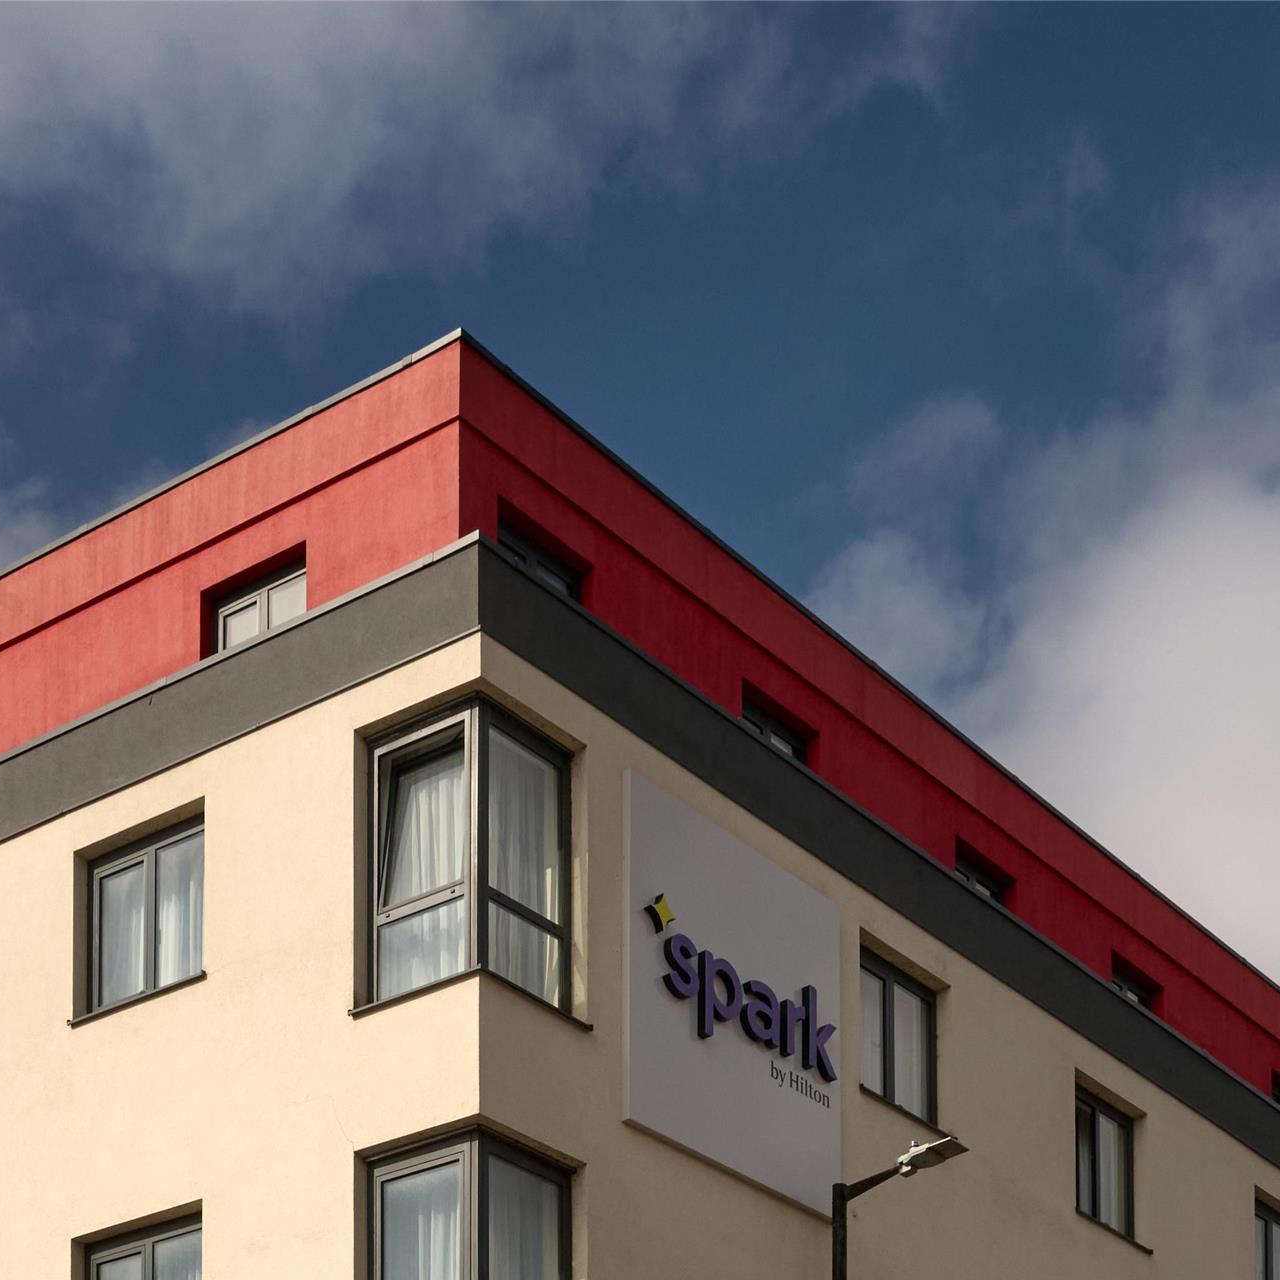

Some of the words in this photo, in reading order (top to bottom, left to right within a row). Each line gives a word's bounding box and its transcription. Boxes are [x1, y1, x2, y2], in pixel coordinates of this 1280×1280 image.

[662, 933, 838, 1083] spark
[770, 1060, 787, 1088] by
[788, 1071, 831, 1109] Hilton
